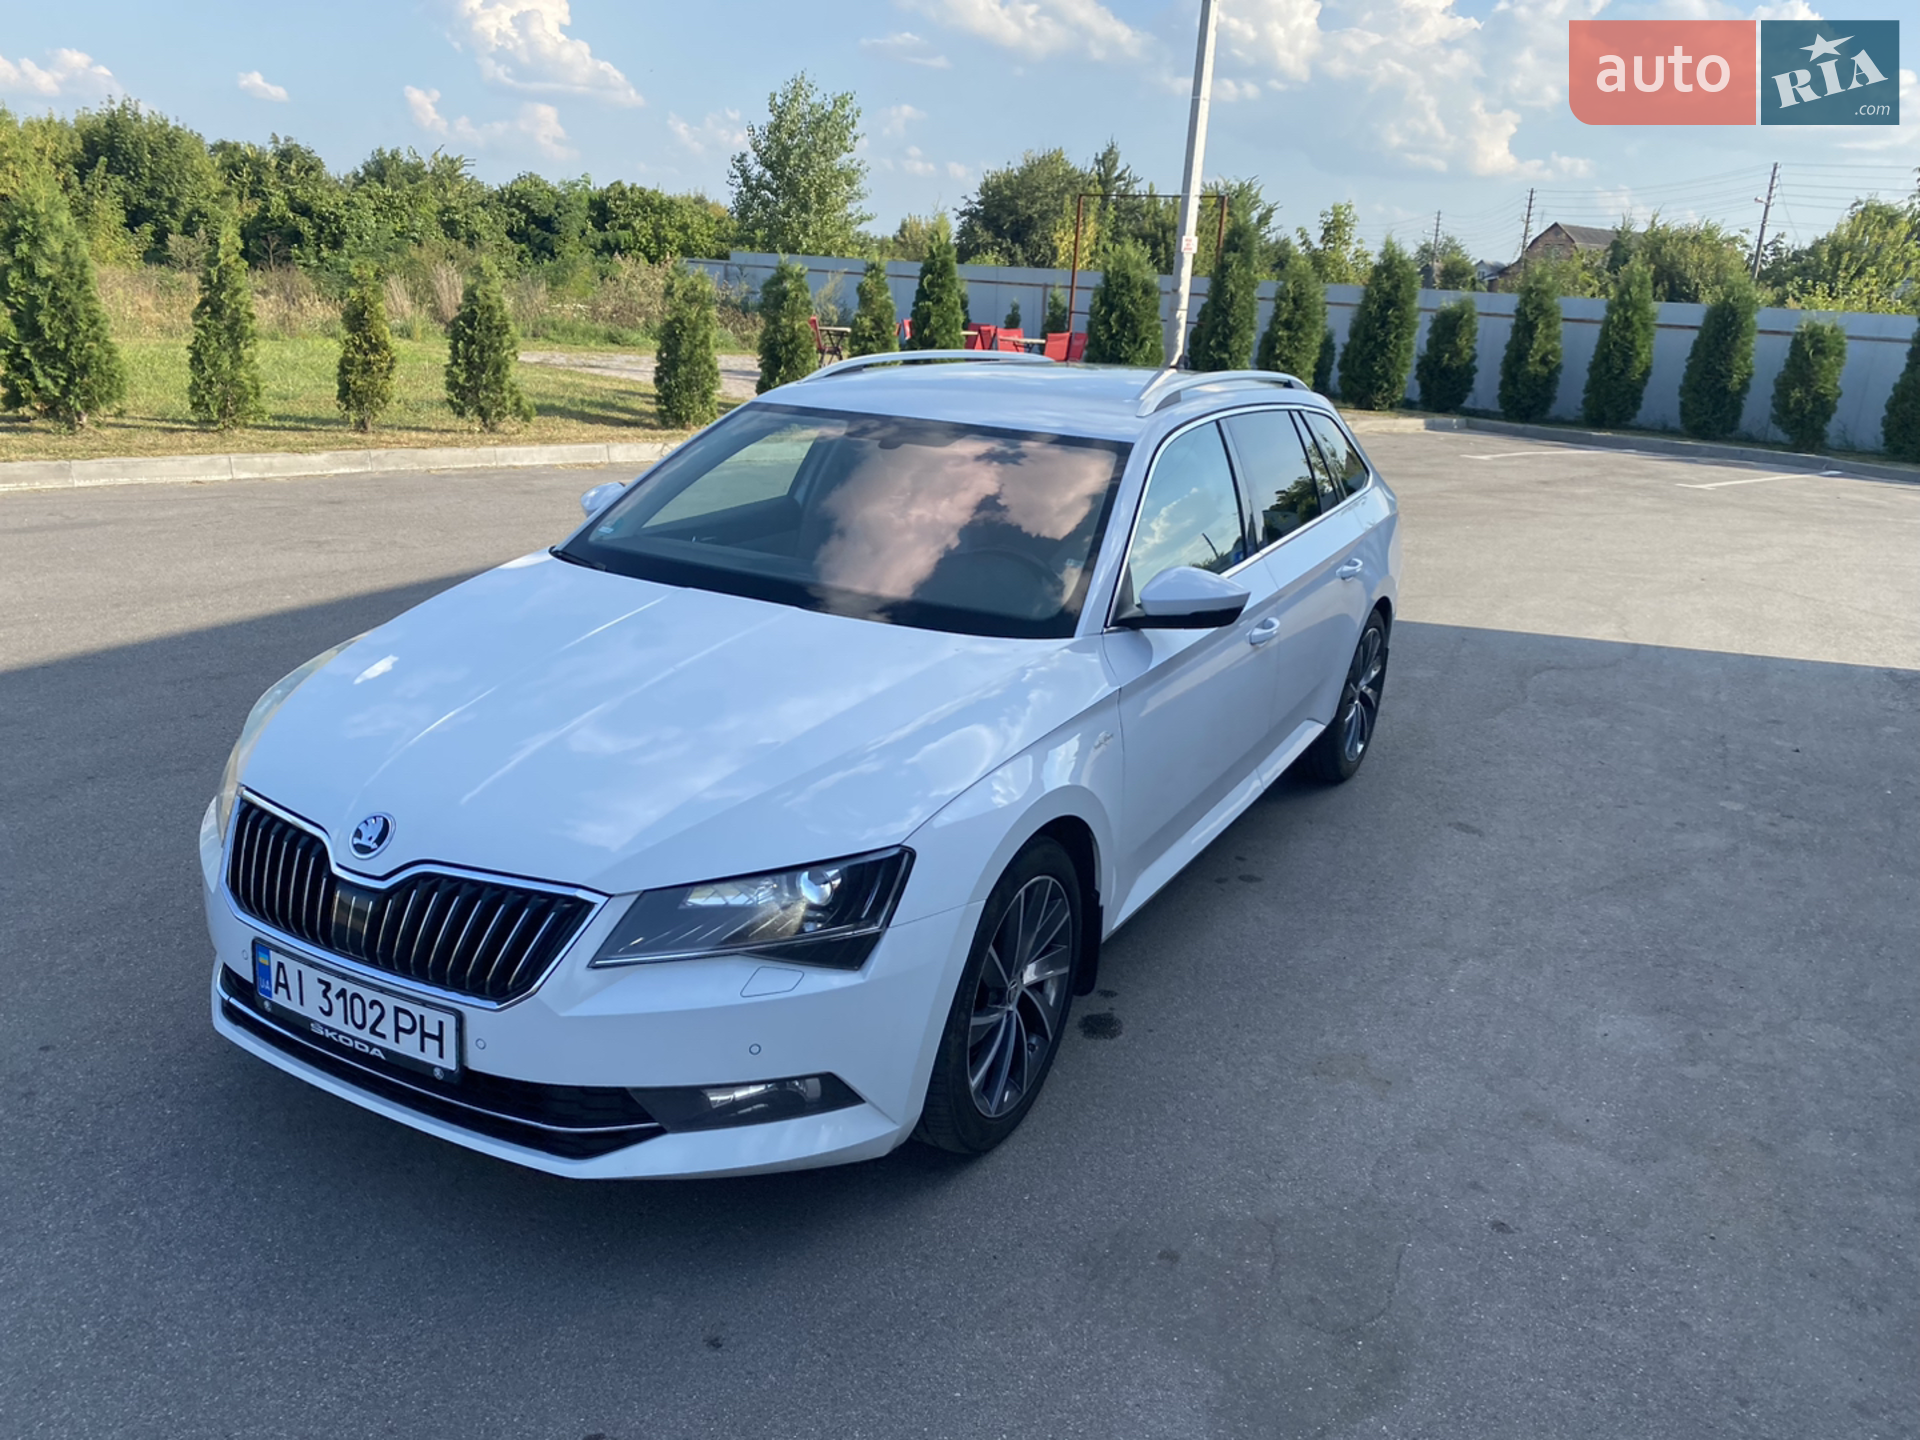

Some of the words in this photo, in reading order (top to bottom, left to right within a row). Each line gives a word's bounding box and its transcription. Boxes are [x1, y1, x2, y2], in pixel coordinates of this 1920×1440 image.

[274, 961, 304, 1007] AI
[316, 978, 388, 1040] 3102
[394, 1005, 444, 1060] PH
